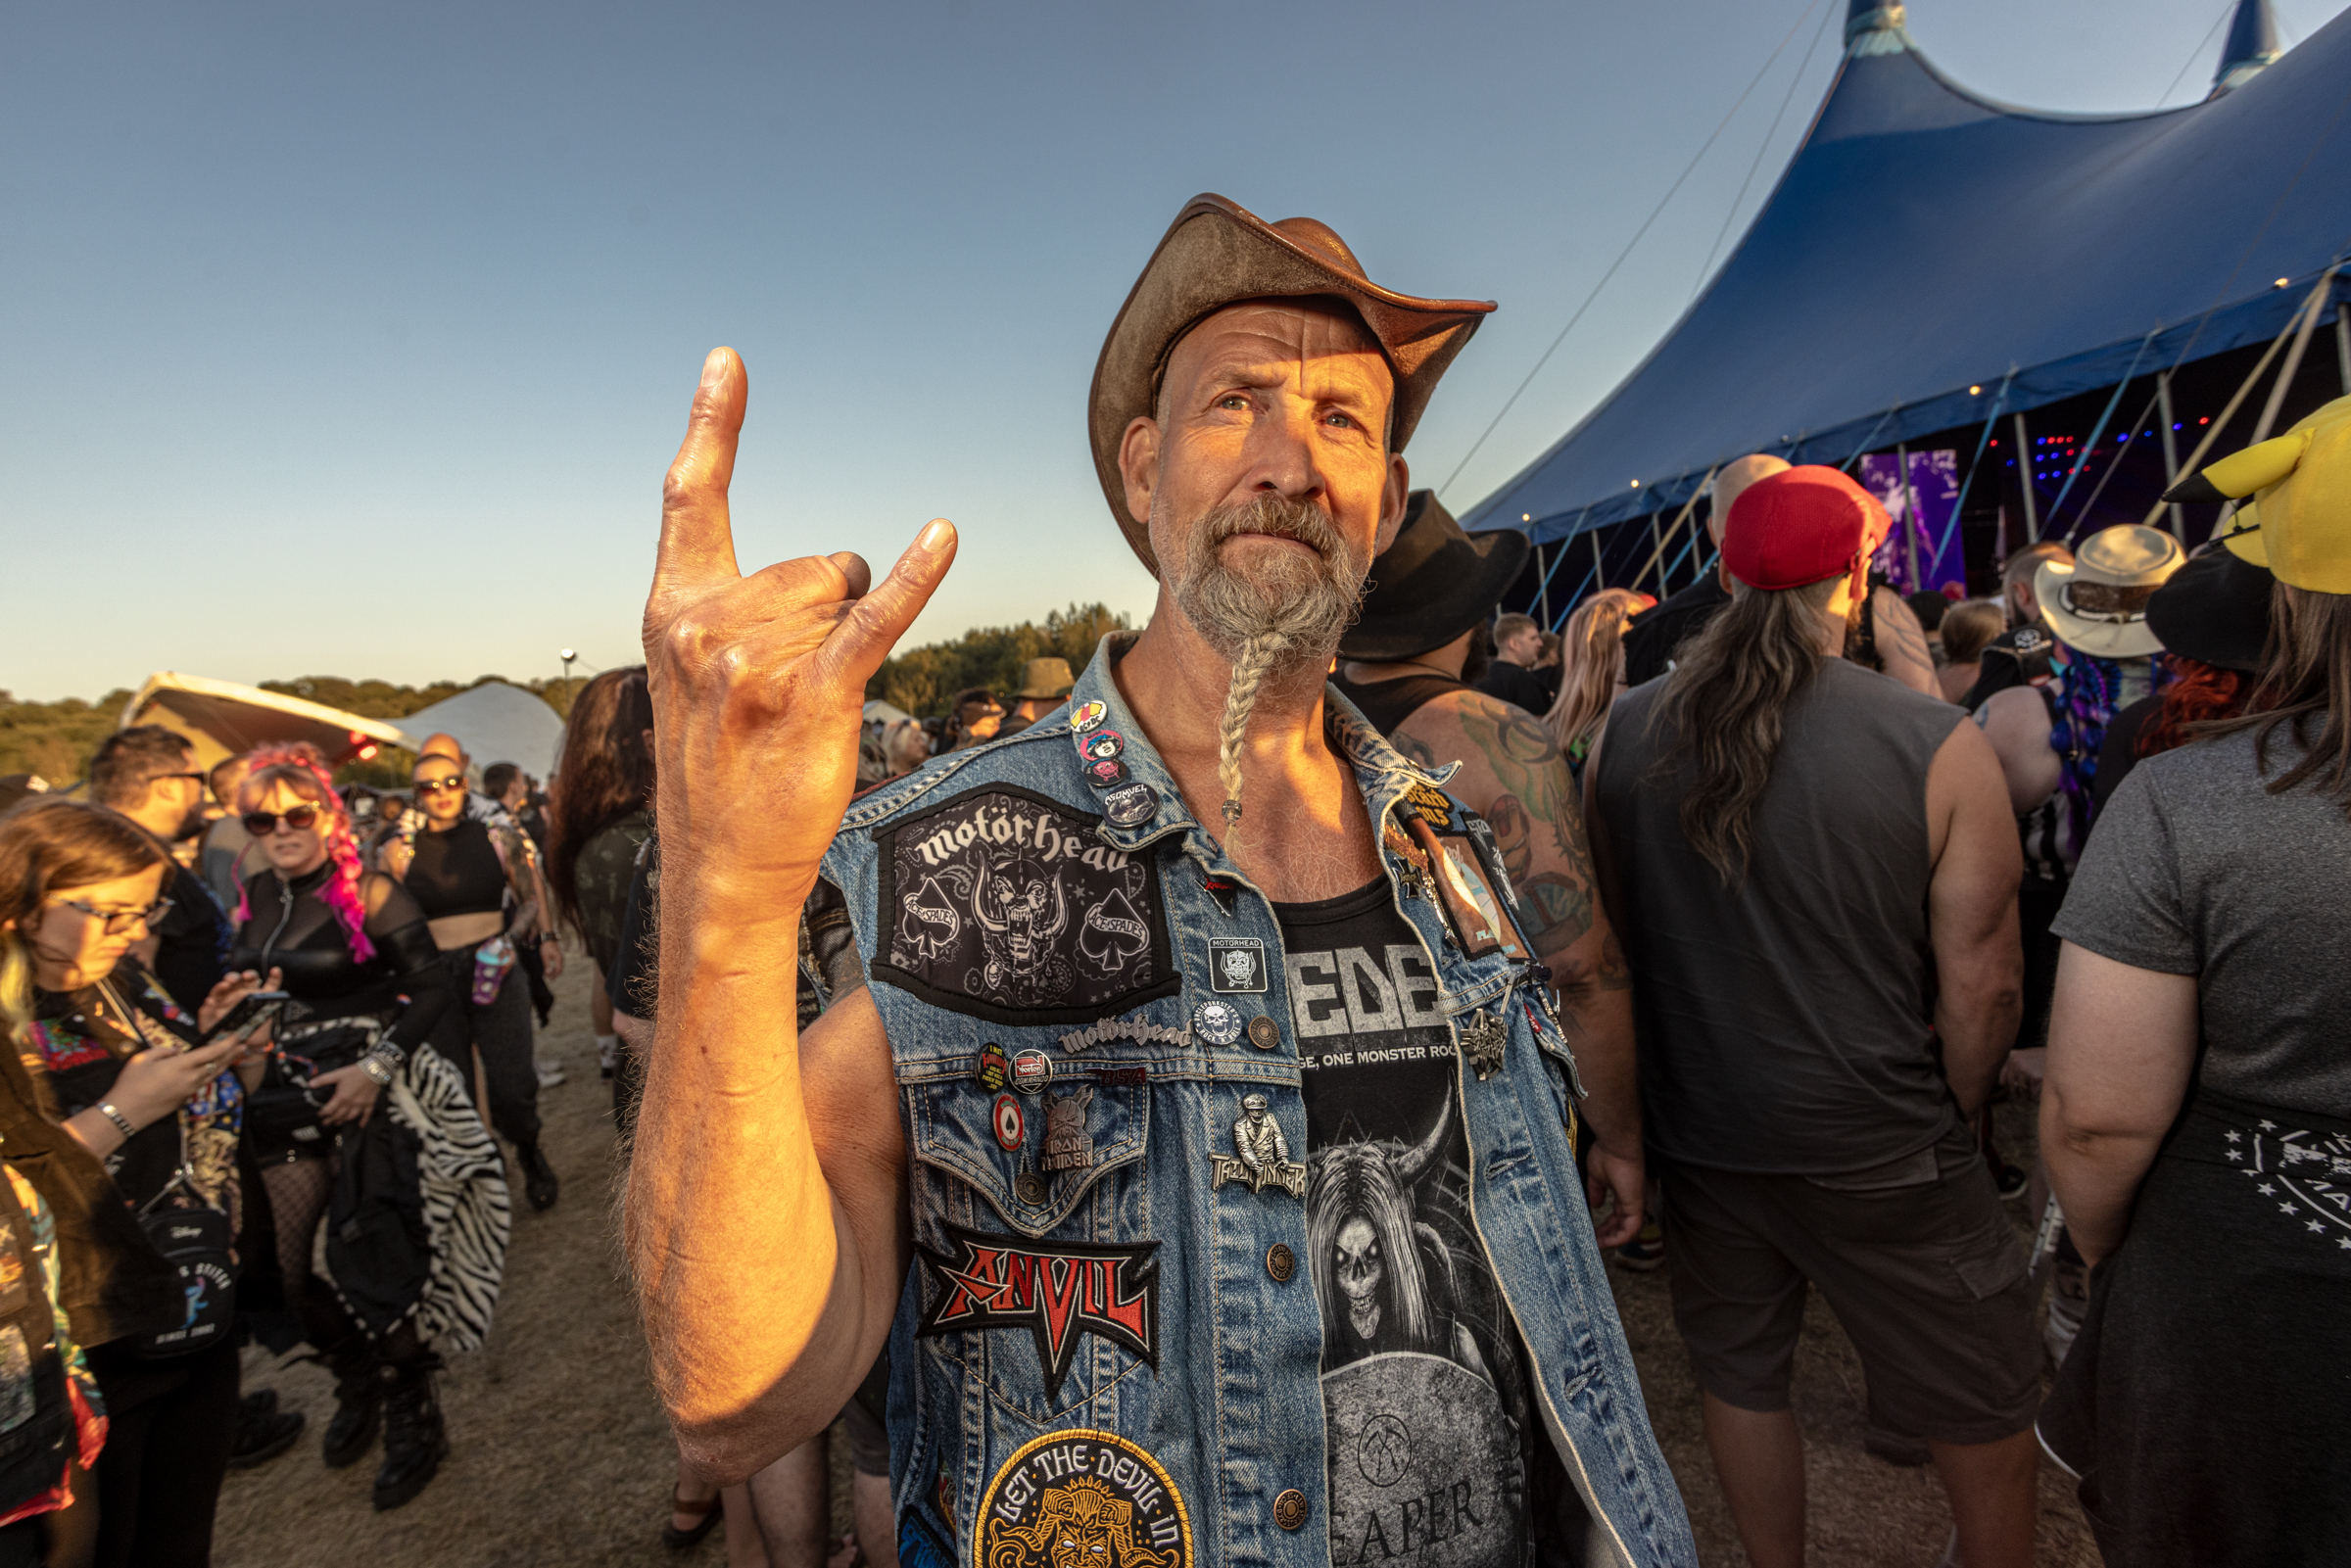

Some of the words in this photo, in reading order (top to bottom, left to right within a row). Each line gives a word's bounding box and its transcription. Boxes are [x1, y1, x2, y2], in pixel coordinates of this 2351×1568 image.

[1105, 784, 1148, 805] ASOMVEL
[906, 900, 923, 917] ACE
[924, 909, 954, 925] SPADES
[1089, 912, 1107, 929] ACE
[1109, 919, 1143, 937] SPADES
[1199, 1029, 1217, 1043] ROCK
[1227, 1026, 1241, 1041] ROLL
[1322, 1052, 1355, 1067] ONE
[1357, 1047, 1426, 1065] MONSTER
[1015, 1074, 1049, 1085] COMMANDO
[1017, 1064, 1043, 1075] Norton
[1101, 1067, 1147, 1086] BSA
[1050, 1137, 1081, 1155] IRON
[1041, 1151, 1092, 1171] MAIDEN
[170, 1226, 203, 1240] Disney
[933, 1240, 1152, 1374] ANVIL
[994, 1465, 1036, 1522] LET
[1033, 1445, 1089, 1483] THE
